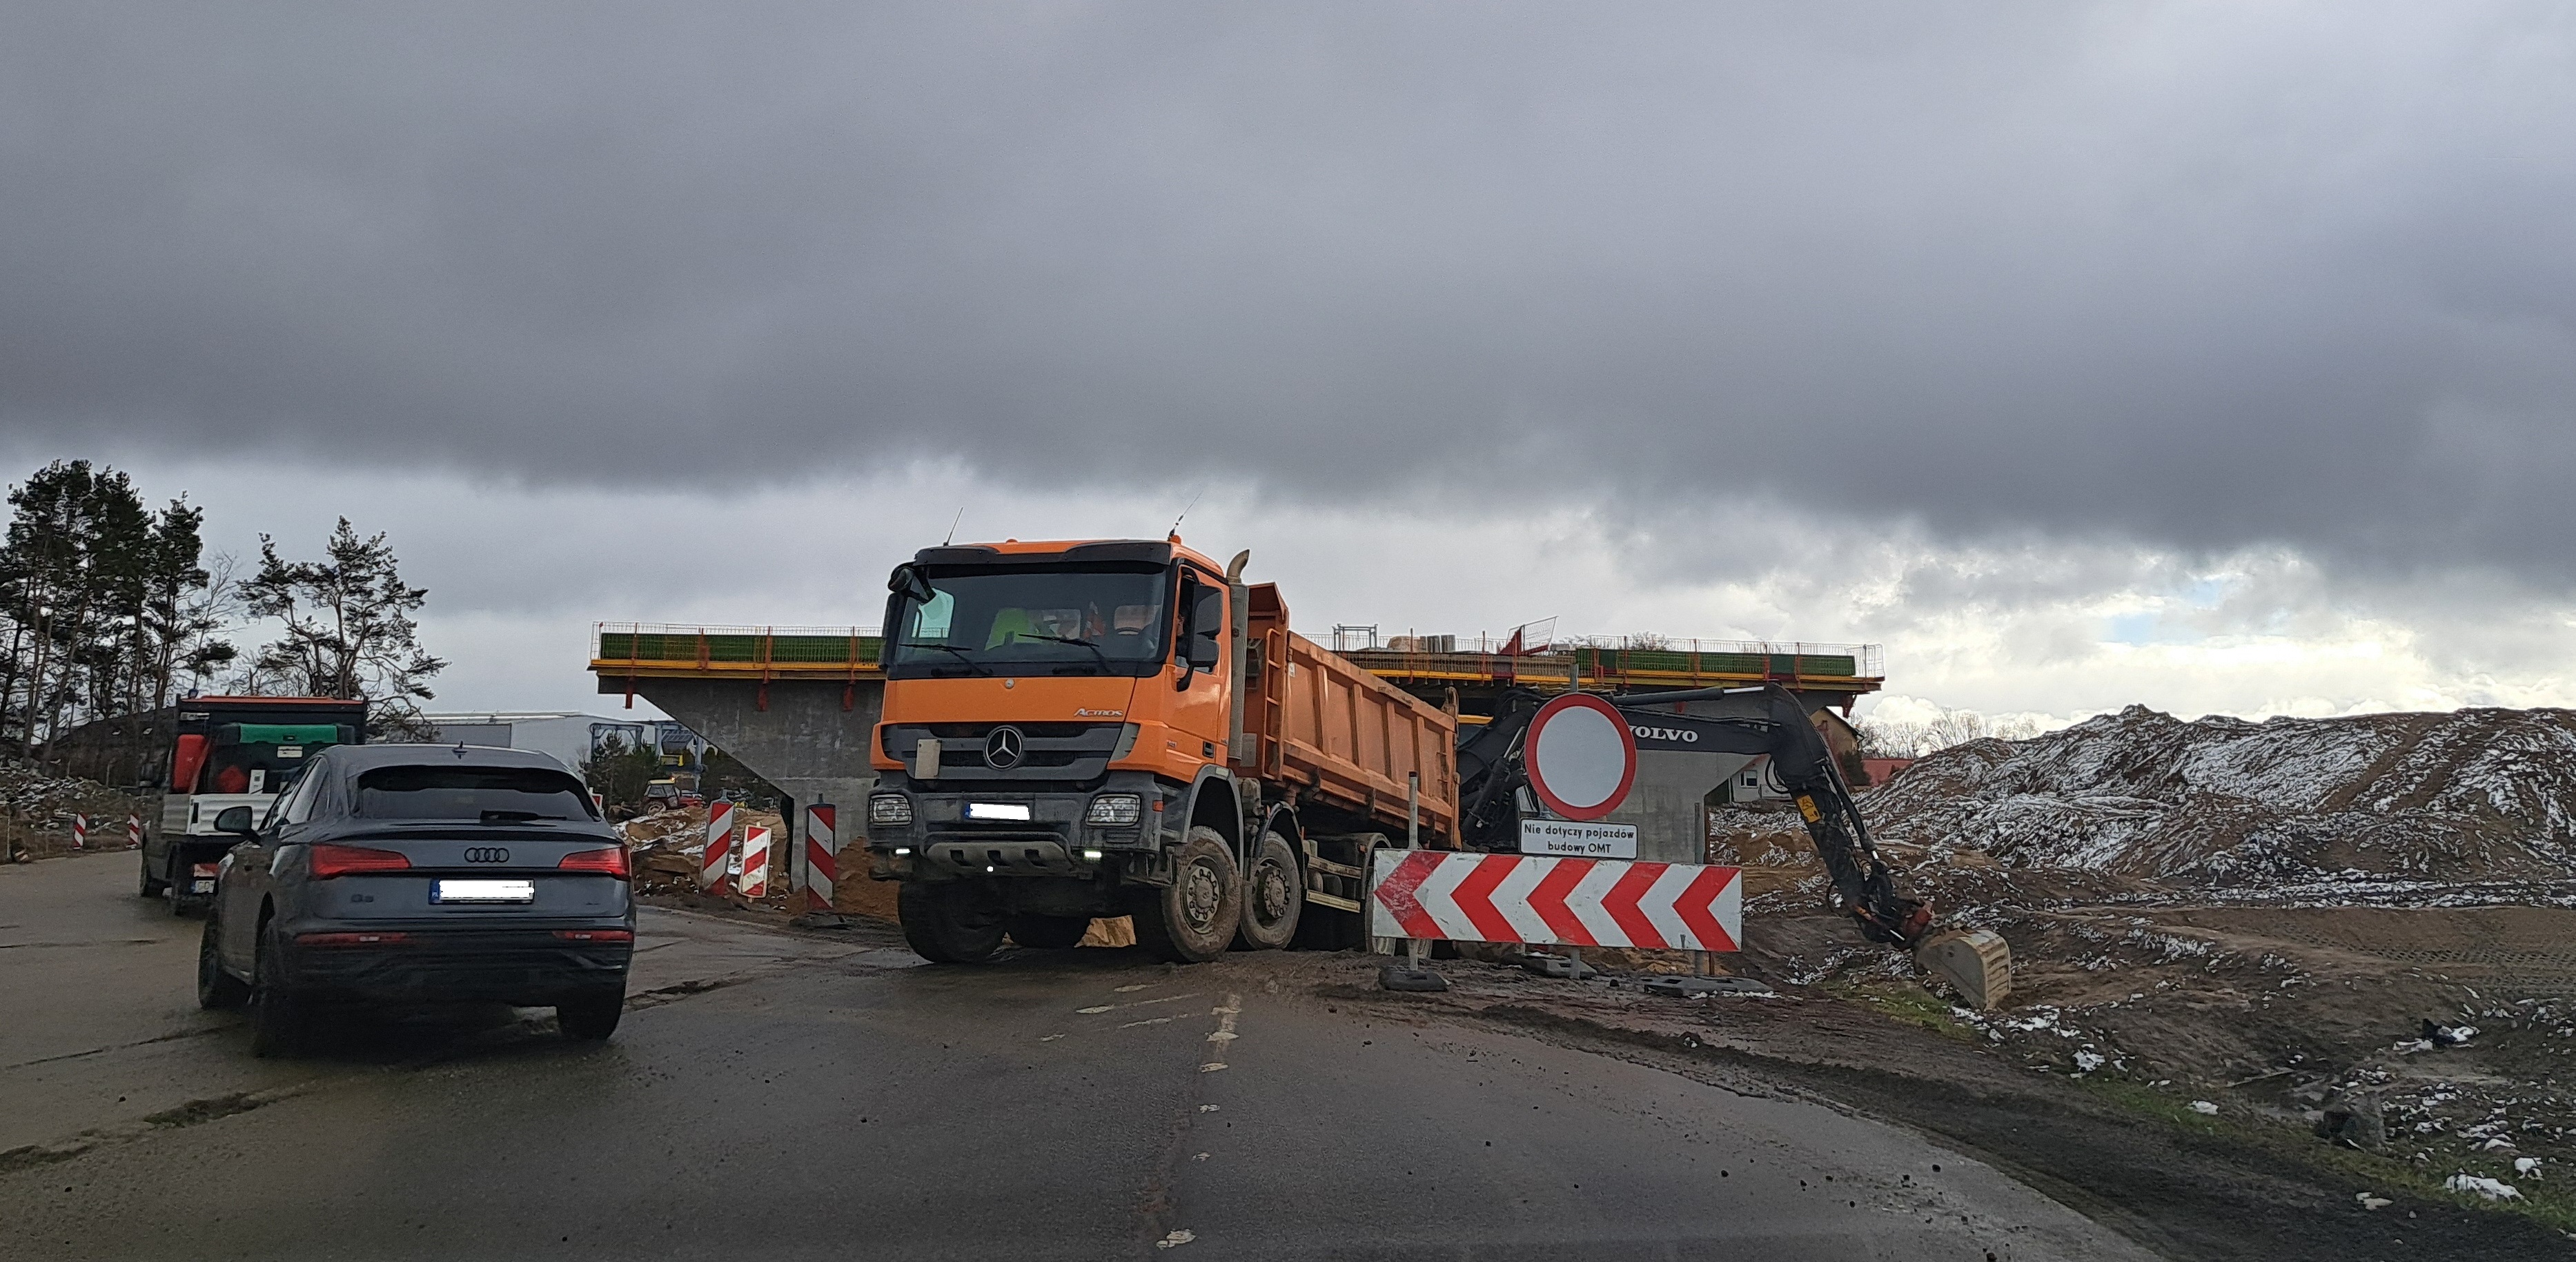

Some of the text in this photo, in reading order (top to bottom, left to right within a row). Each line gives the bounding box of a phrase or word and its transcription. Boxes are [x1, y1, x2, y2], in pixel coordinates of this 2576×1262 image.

[1524, 823, 1635, 839] Nie dotyczy pojazdów
[1548, 841, 1611, 854] budowy OMT
